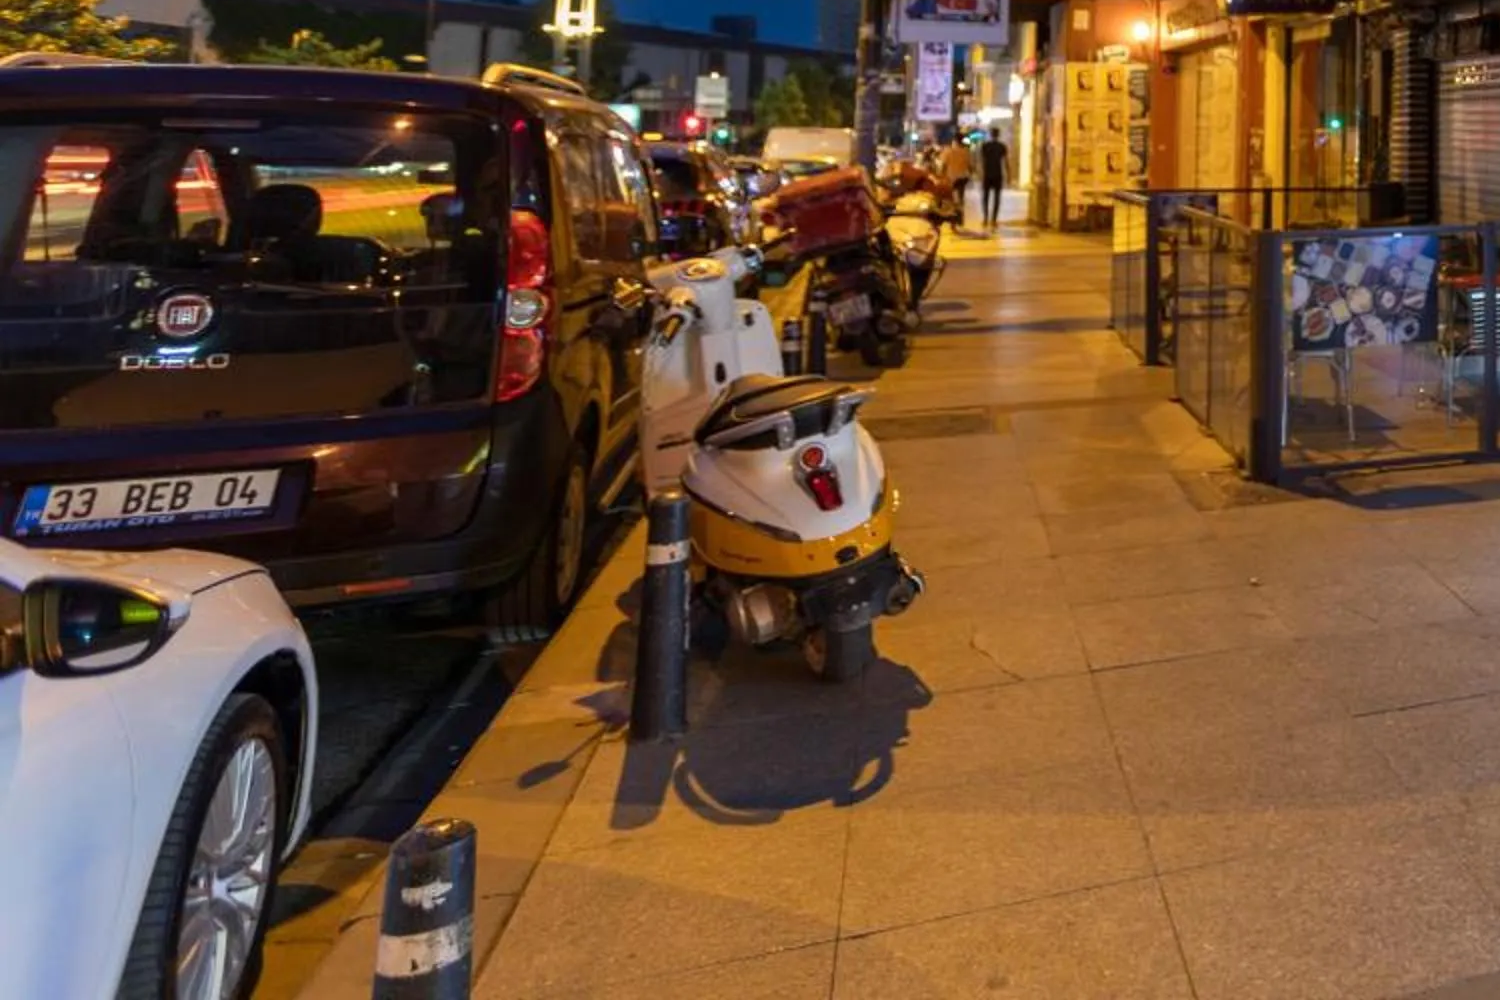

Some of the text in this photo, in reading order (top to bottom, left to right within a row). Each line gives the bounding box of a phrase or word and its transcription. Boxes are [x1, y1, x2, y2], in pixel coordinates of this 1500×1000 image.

[169, 305, 200, 325] FIAT
[47, 475, 257, 520] 33 BEB 04
